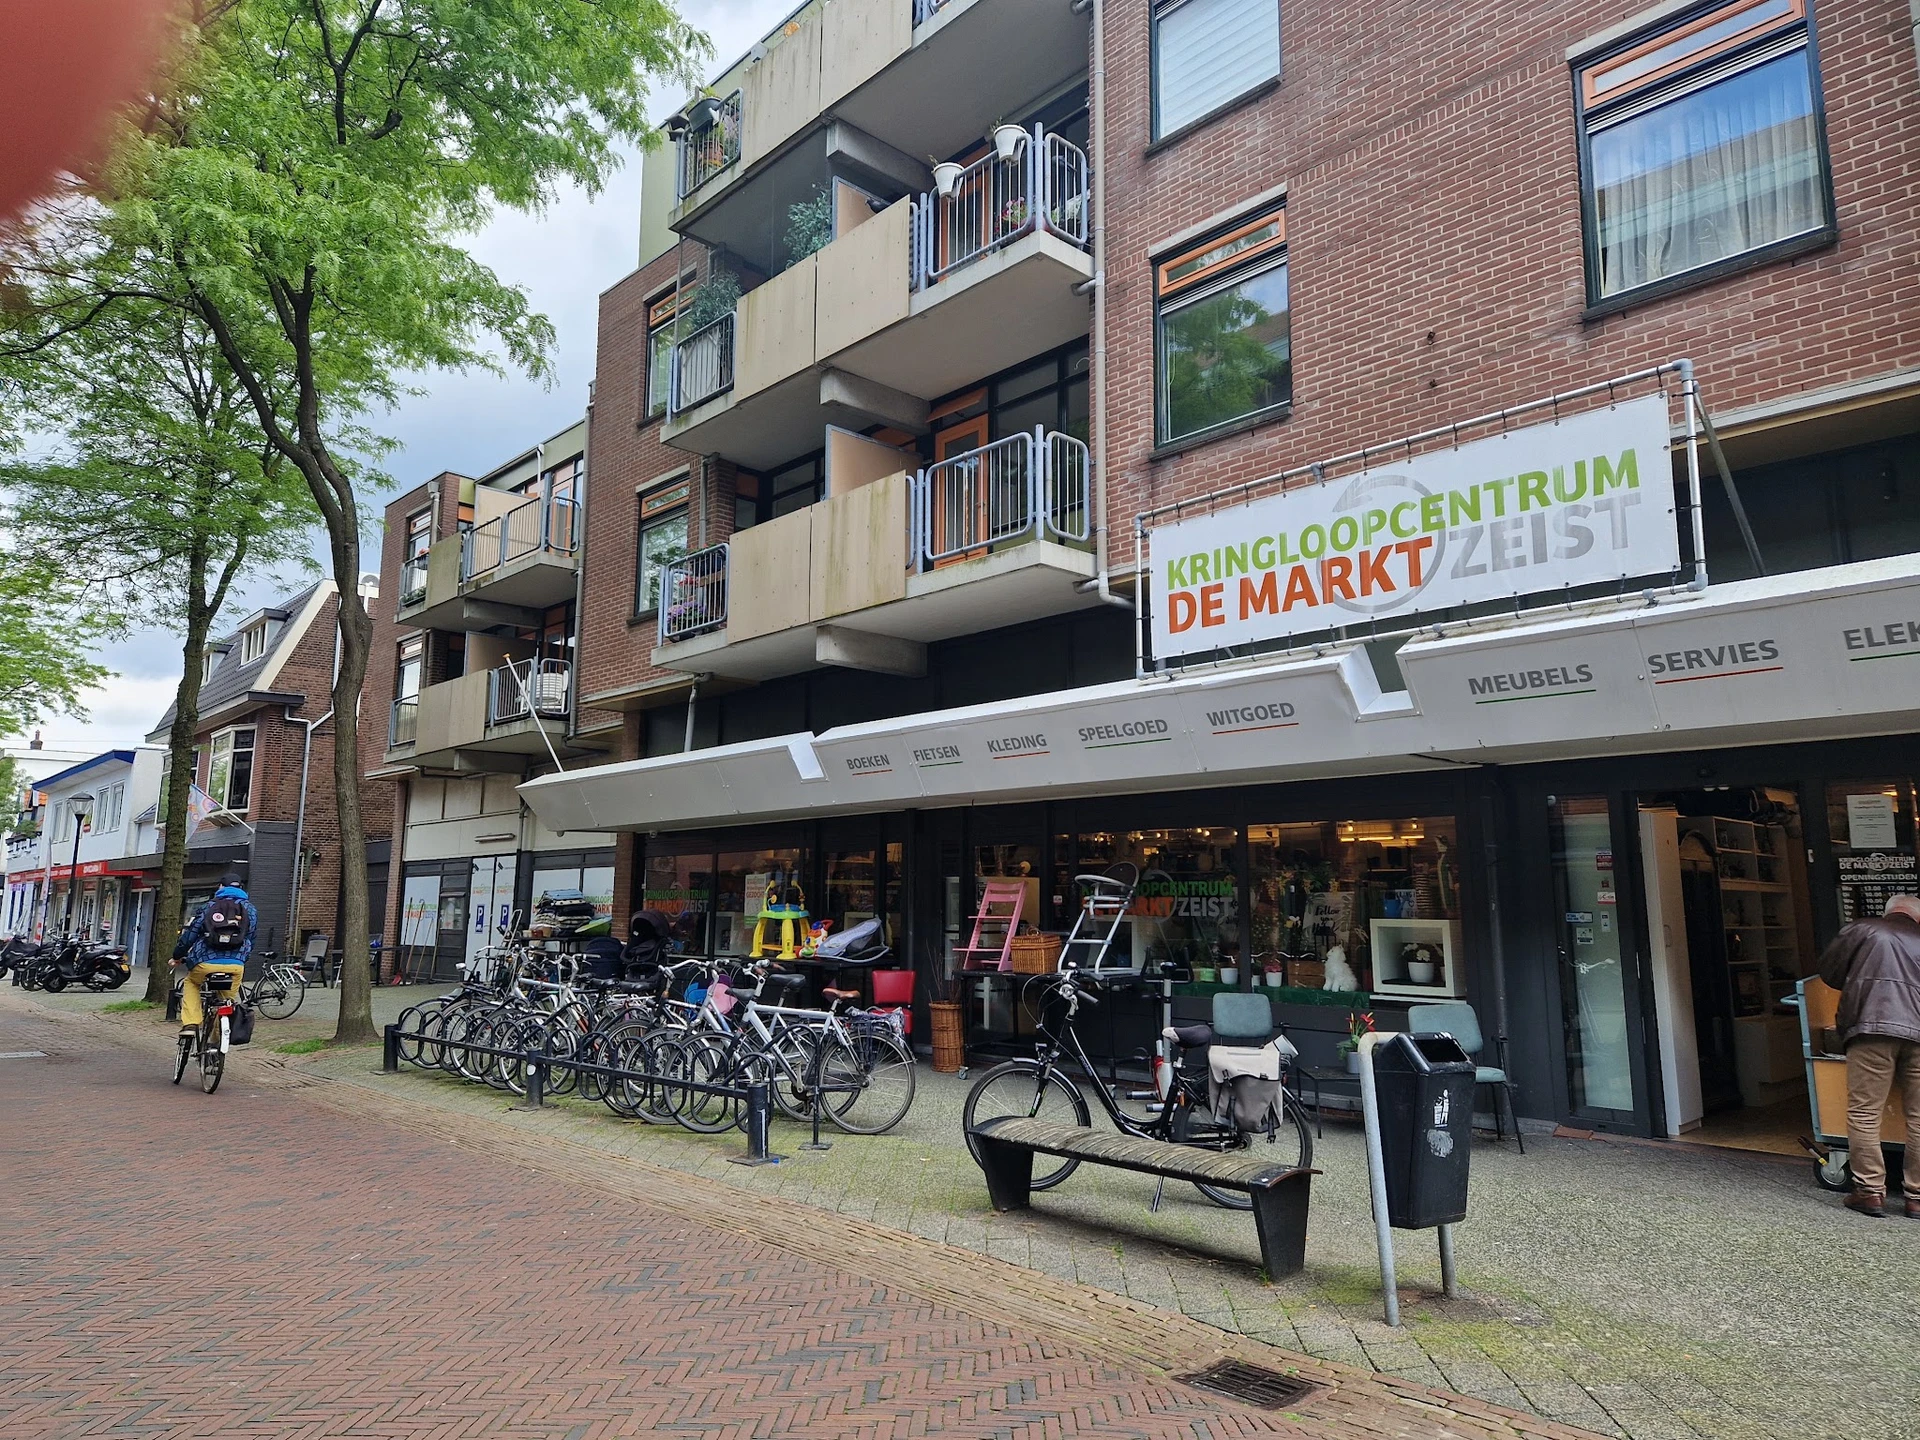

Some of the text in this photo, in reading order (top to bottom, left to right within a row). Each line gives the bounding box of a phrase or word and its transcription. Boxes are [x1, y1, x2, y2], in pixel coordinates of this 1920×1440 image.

[1167, 448, 1641, 590] KRINGLOOPCENTRUM
[1168, 492, 1642, 634] DE MARKT ZEIST
[1843, 621, 1920, 650] ELEK
[1647, 638, 1780, 674] SERVIES
[1468, 663, 1594, 696] MEUBELS
[1206, 702, 1296, 727] WITGOED
[1078, 718, 1169, 742] SPEELGOED
[913, 744, 961, 762] FIETSEN
[987, 733, 1048, 753] KLEDING
[846, 754, 891, 770] BOEKEN
[1840, 873, 1918, 881] OPENINGSTIJDEN
[1178, 896, 1234, 917] ZEIST
